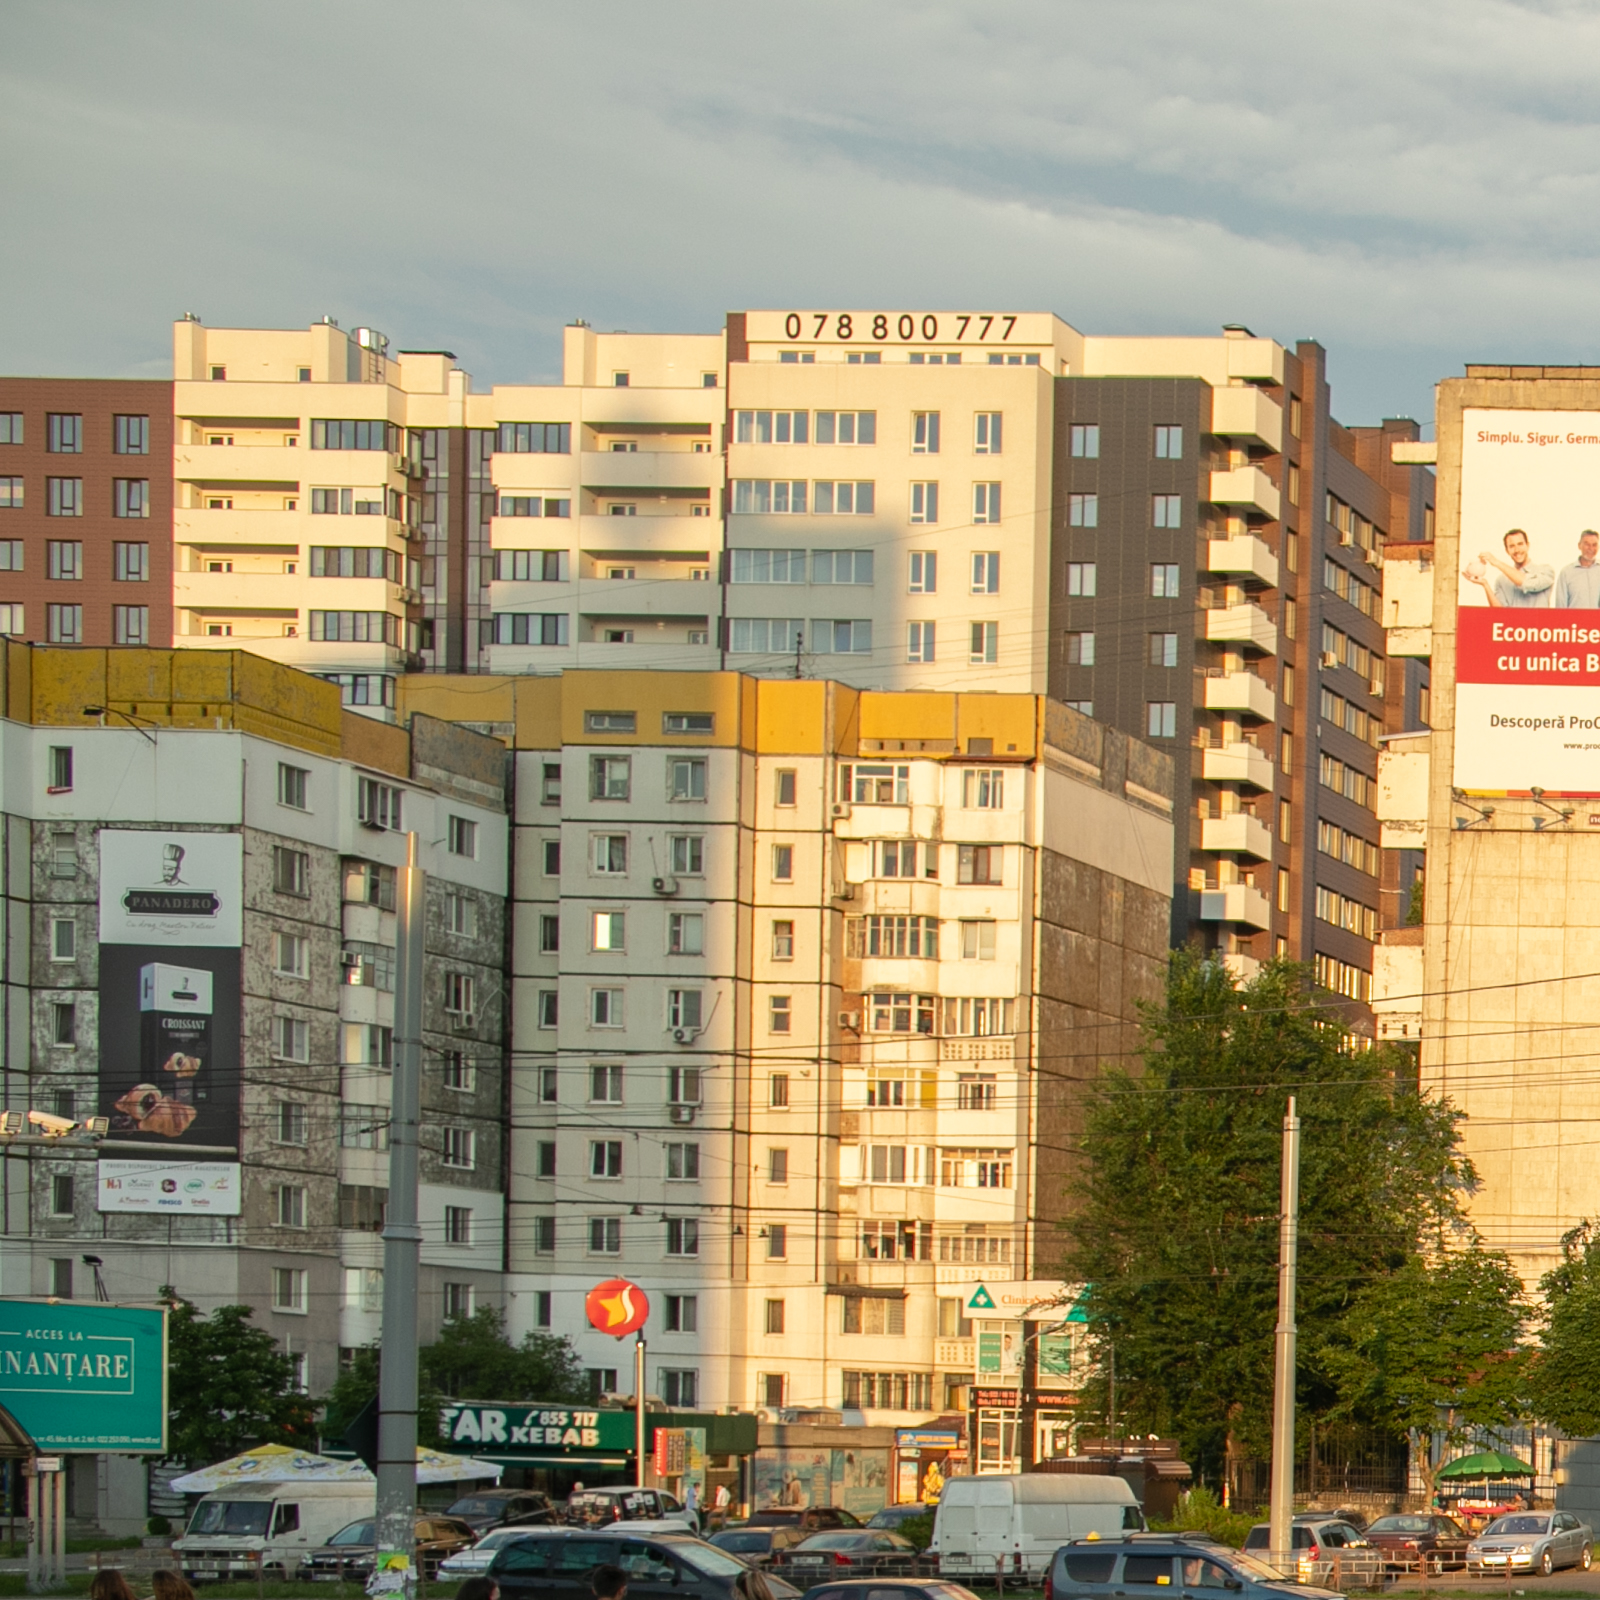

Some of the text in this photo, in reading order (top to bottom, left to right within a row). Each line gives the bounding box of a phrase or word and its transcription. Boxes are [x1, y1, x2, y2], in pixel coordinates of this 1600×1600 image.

[785, 313, 1018, 341] 078 800 777
[1477, 431, 1523, 446] Simplu.
[1527, 432, 1563, 446] Sigur.
[1497, 656, 1520, 671] cu
[1526, 652, 1580, 672] unica
[1490, 714, 1565, 731] Descoperă
[132, 897, 212, 909] PANADERO
[162, 1018, 206, 1030] CROISSANT
[25, 1329, 83, 1341] ACCES LA
[540, 1411, 599, 1427] 855 717
[511, 1426, 600, 1447] KEBAB
